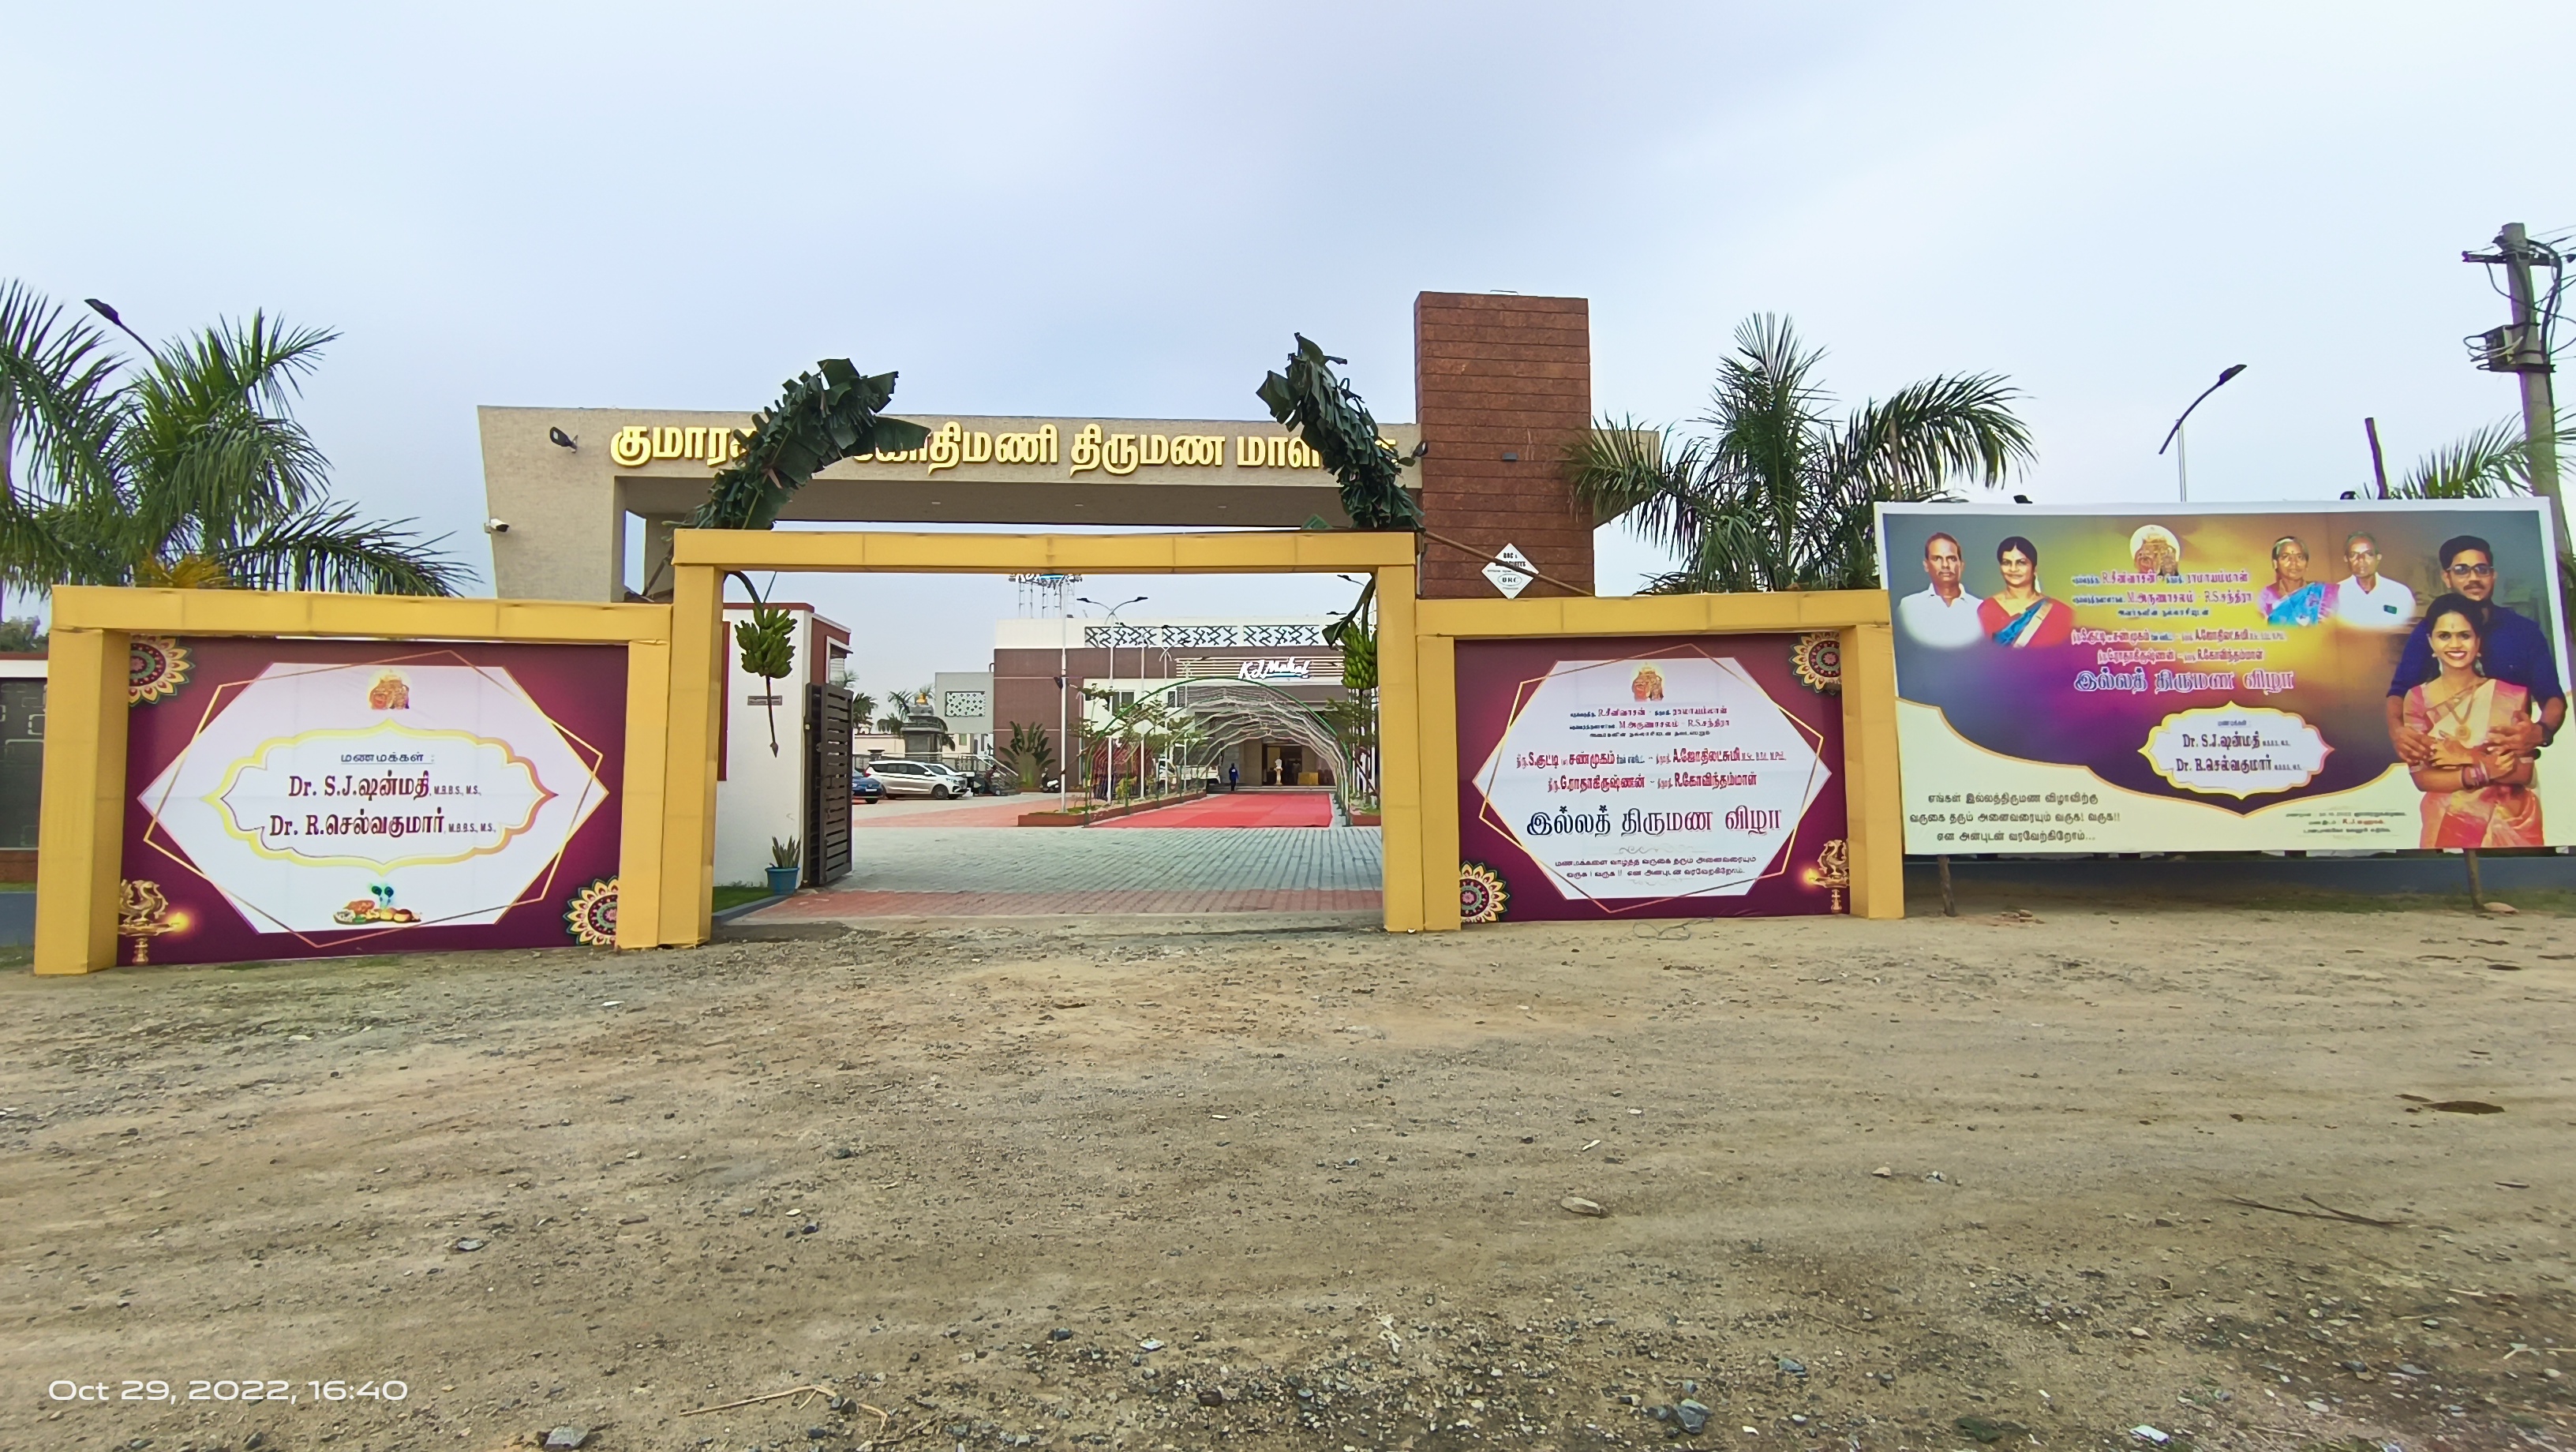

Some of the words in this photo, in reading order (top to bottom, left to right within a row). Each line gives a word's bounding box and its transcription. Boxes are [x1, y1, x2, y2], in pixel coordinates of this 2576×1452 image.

[1070, 423, 1226, 478] திருமண
[2074, 667, 2148, 694] இல்லத்
[2155, 669, 2234, 694] திருமண
[2242, 668, 2293, 695] விழா
[2182, 734, 2199, 747] Dr.
[2176, 758, 2192, 772] Dr.
[288, 776, 317, 797] Dr.
[1928, 792, 1961, 803] எங்கள்
[269, 814, 298, 836] Dr.
[1526, 804, 1611, 837] இல்லத்
[1621, 807, 1713, 836] திருமண
[1725, 805, 1781, 837] விழா
[1910, 814, 1945, 825] வருகை
[1949, 810, 1974, 825] தரும்
[1937, 833, 1955, 841] என
